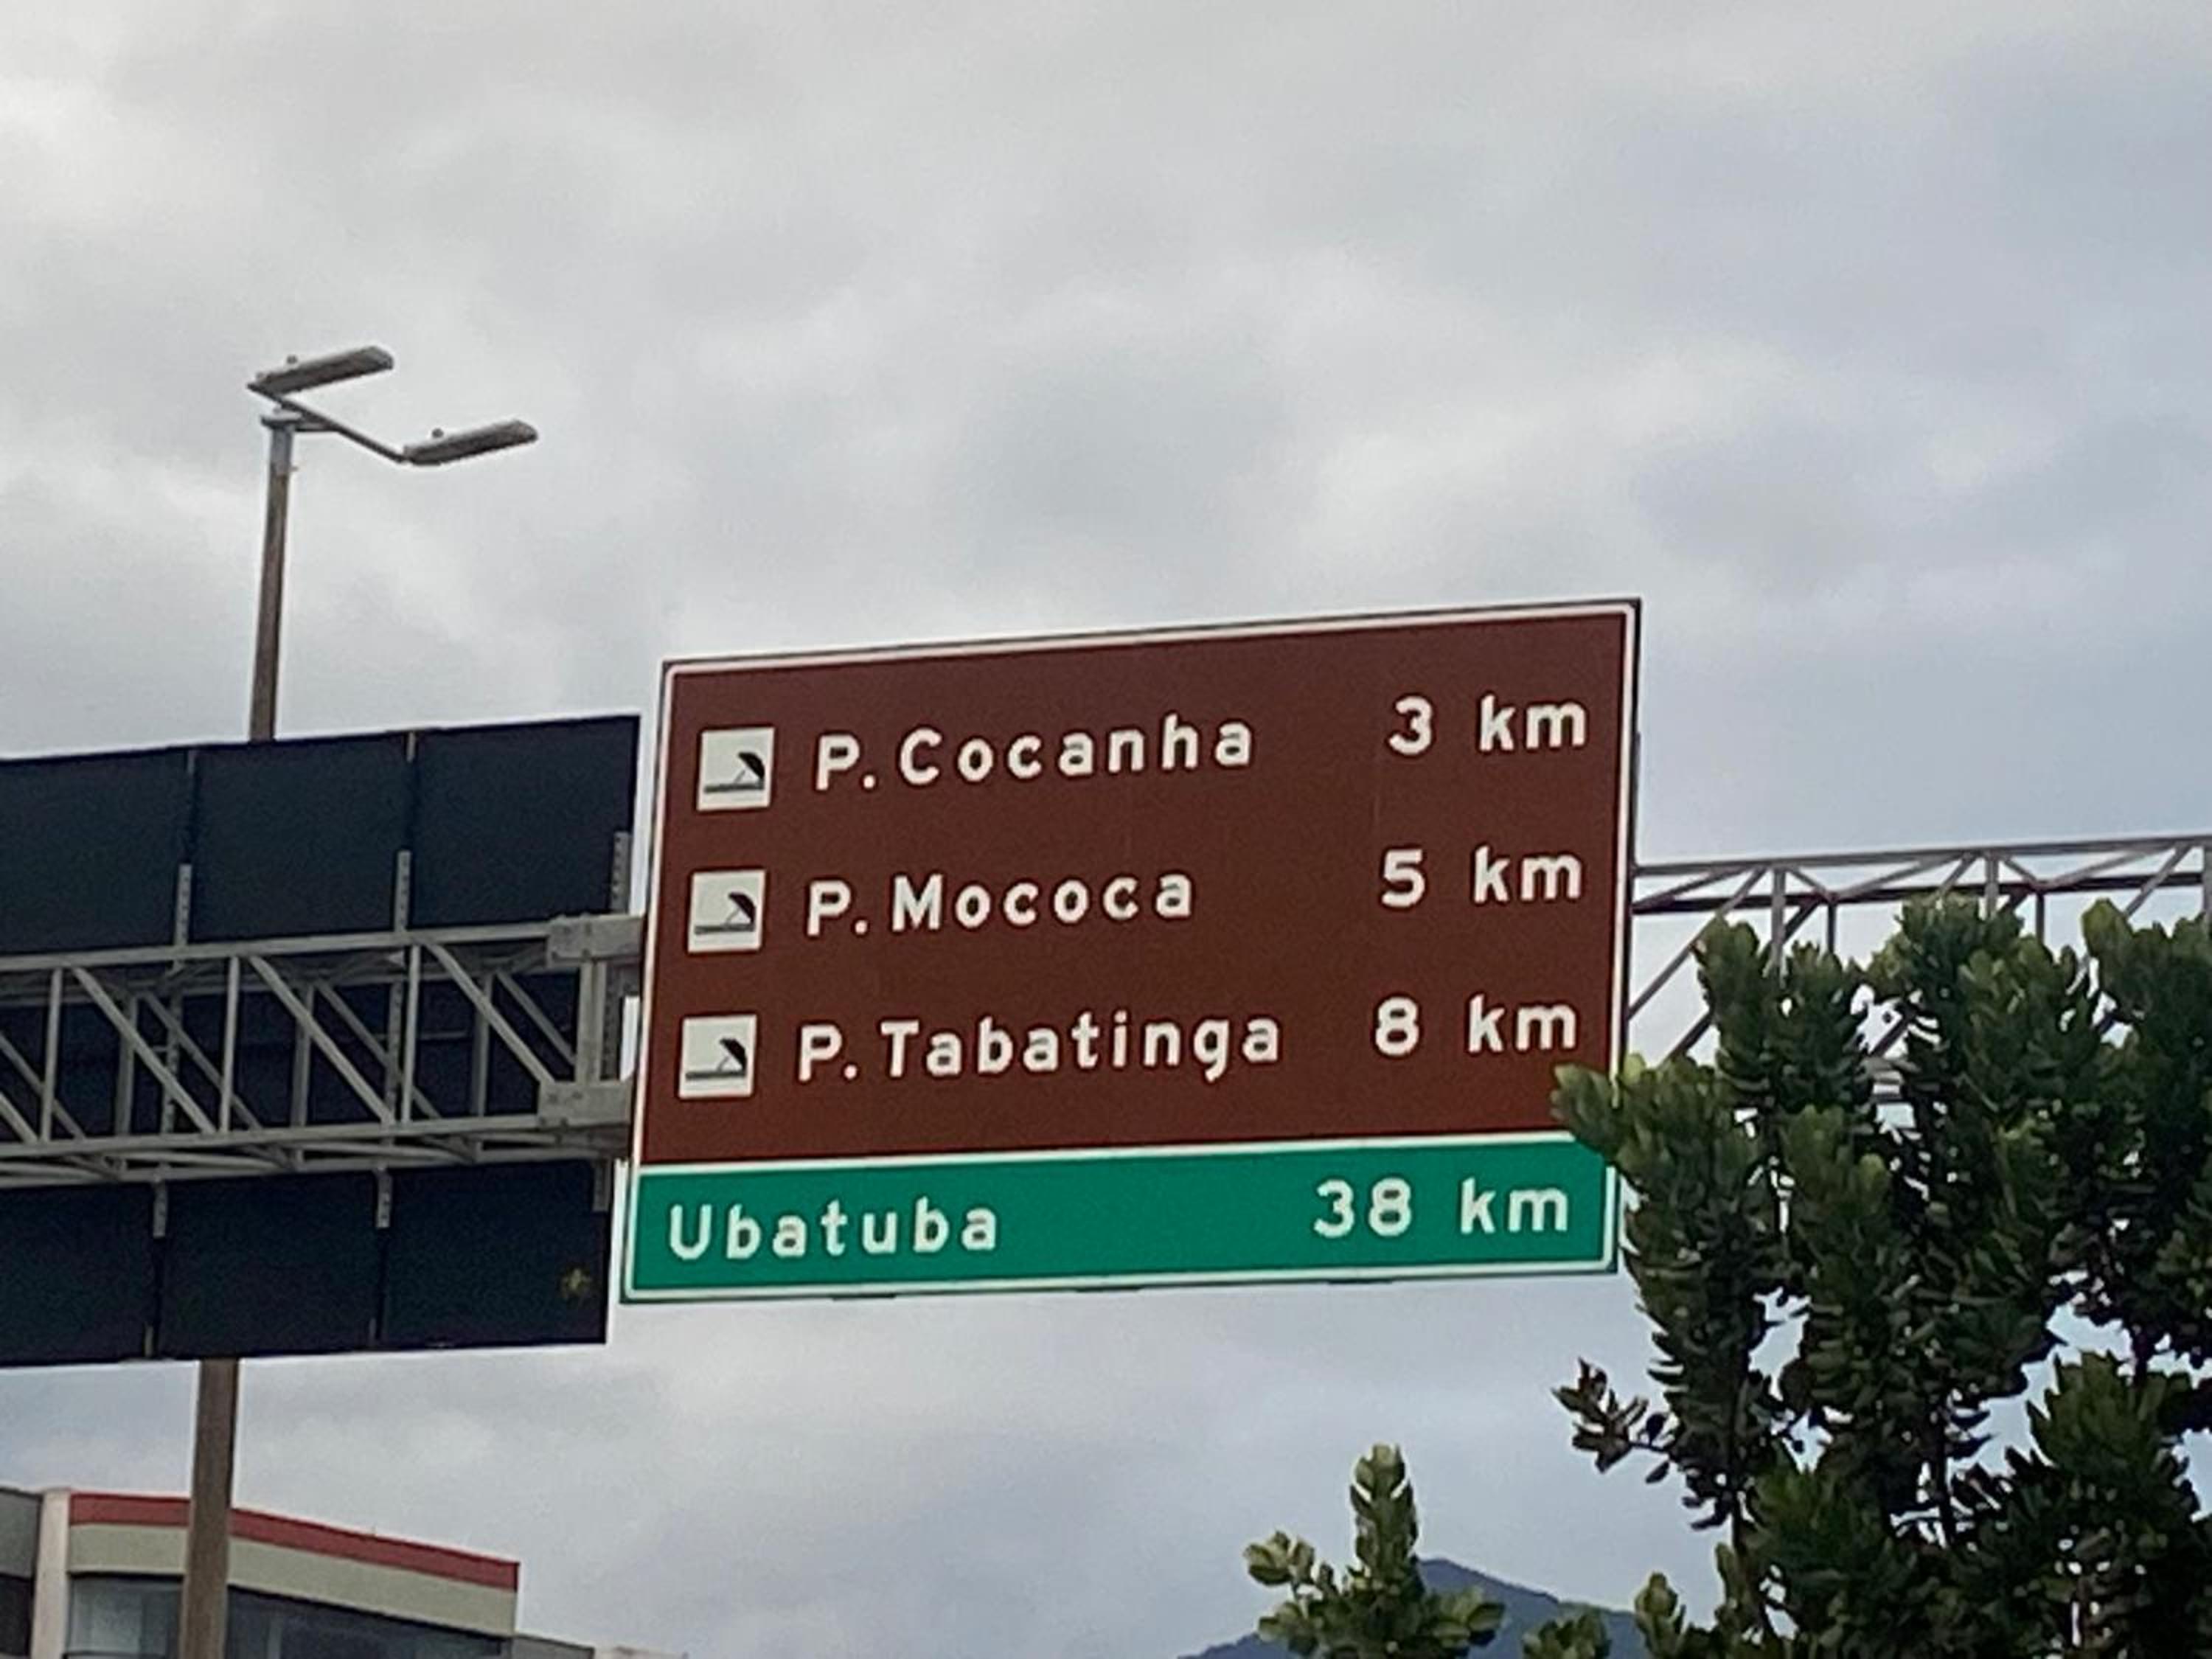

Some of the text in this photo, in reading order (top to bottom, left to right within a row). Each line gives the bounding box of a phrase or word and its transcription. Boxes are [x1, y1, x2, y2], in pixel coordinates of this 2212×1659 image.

[1389, 697, 1432, 755] 3
[1480, 695, 1586, 751] km
[1382, 849, 1425, 907] 5
[1475, 846, 1582, 903] km
[1376, 998, 1419, 1055] 8
[1469, 995, 1576, 1053] km
[669, 1178, 1568, 1262] Ubatuba 38 km
